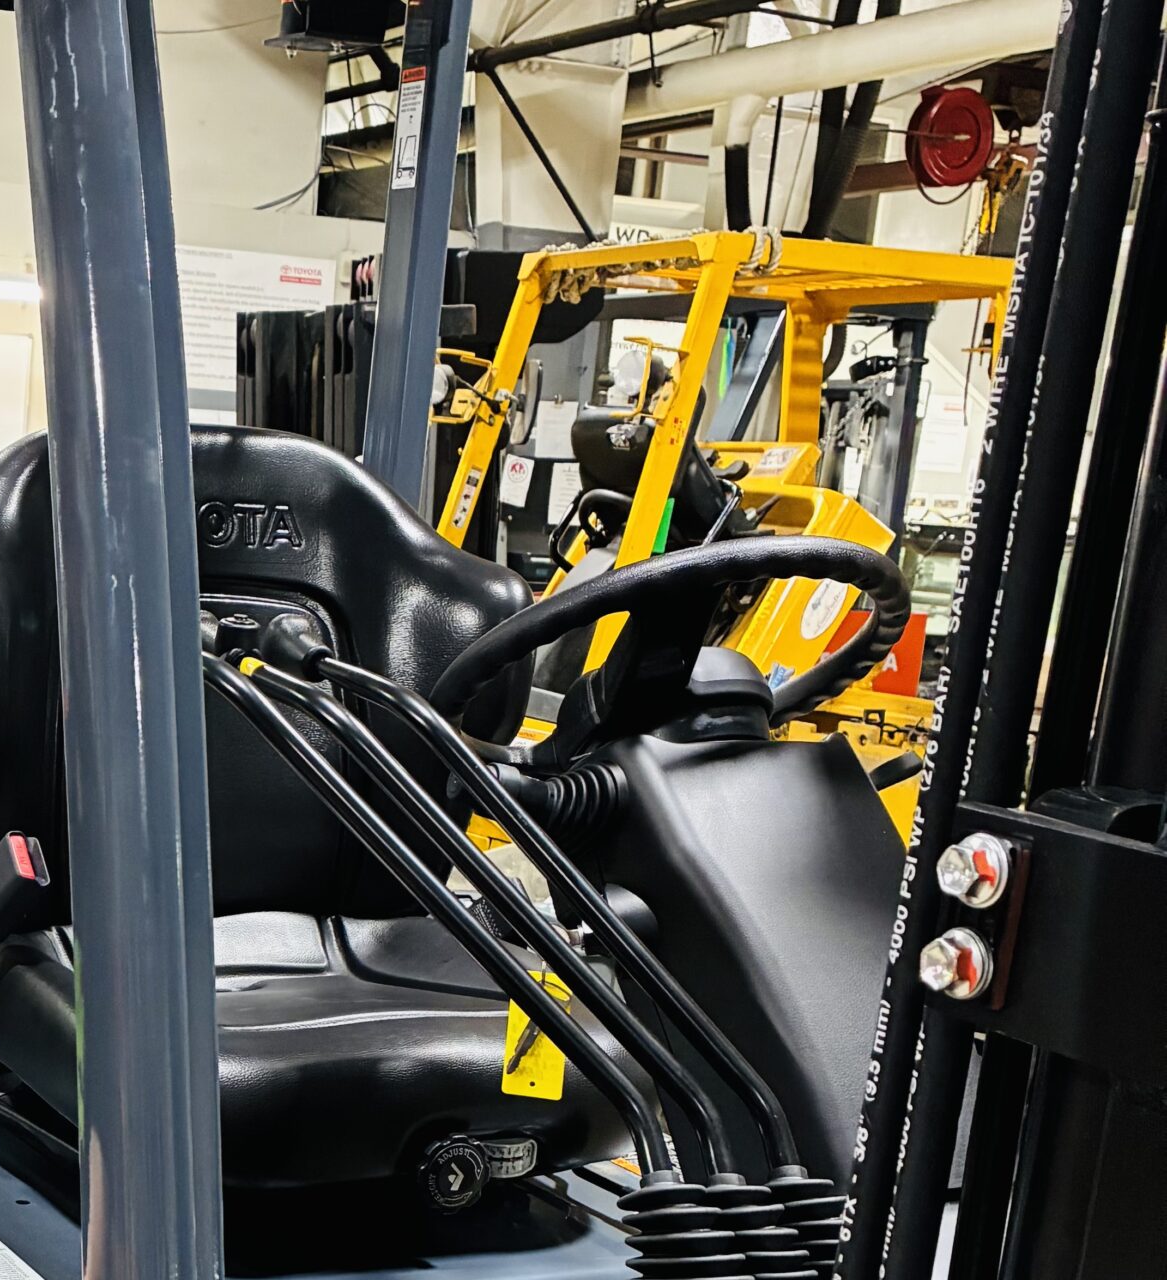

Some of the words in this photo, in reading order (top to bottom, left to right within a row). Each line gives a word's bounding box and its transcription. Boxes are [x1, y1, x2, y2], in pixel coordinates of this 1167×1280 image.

[197, 501, 306, 550] OTA
[873, 999, 891, 1054] mm)
[889, 904, 909, 965] 4000
[899, 855, 919, 899] PSI
[909, 807, 925, 847] WP
[921, 740, 939, 791] (276
[931, 666, 952, 732] BAR)
[984, 355, 1009, 428] WIRE
[1003, 251, 1029, 338] MSHA
